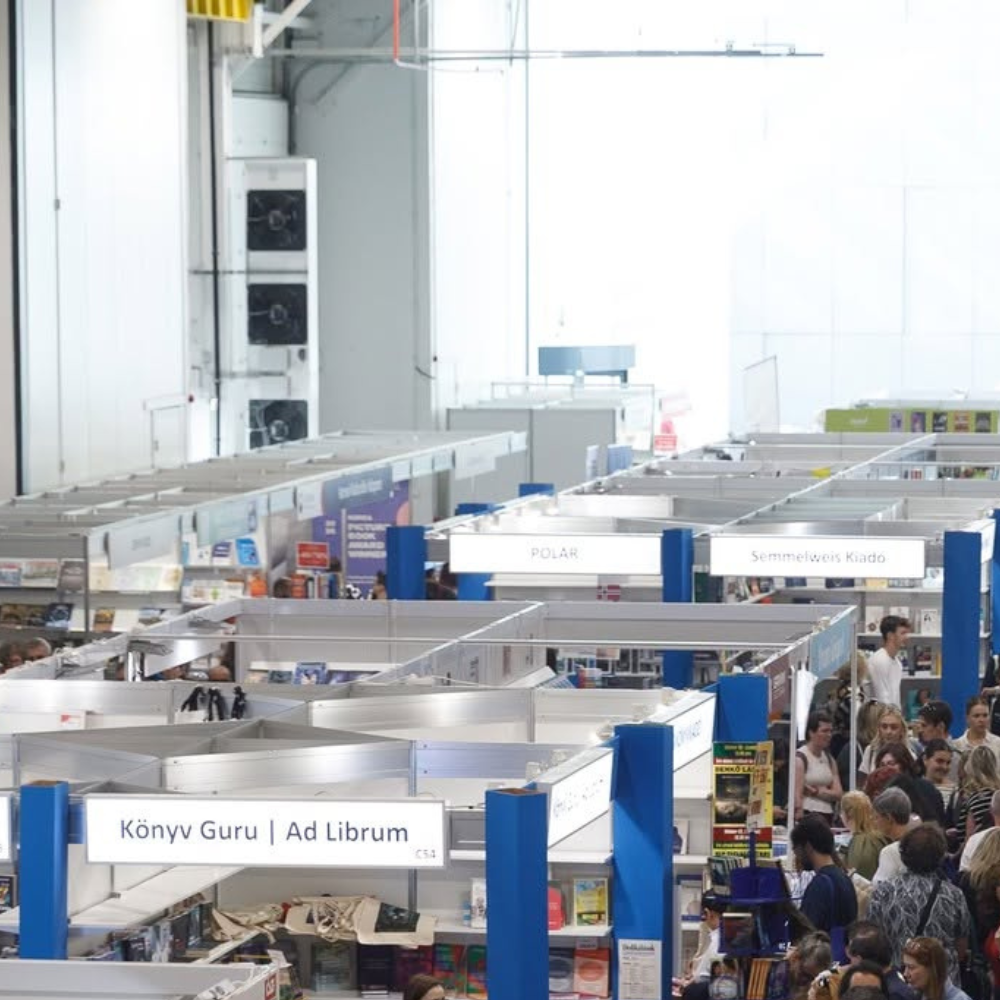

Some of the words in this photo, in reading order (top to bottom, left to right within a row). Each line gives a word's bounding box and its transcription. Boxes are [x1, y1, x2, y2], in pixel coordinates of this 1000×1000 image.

[530, 547, 579, 559] POLAR
[750, 550, 842, 563] Semmelweis
[119, 819, 192, 844] Könyv
[200, 820, 258, 842] Guru
[286, 821, 318, 842] Ad
[326, 820, 409, 843] Librum
